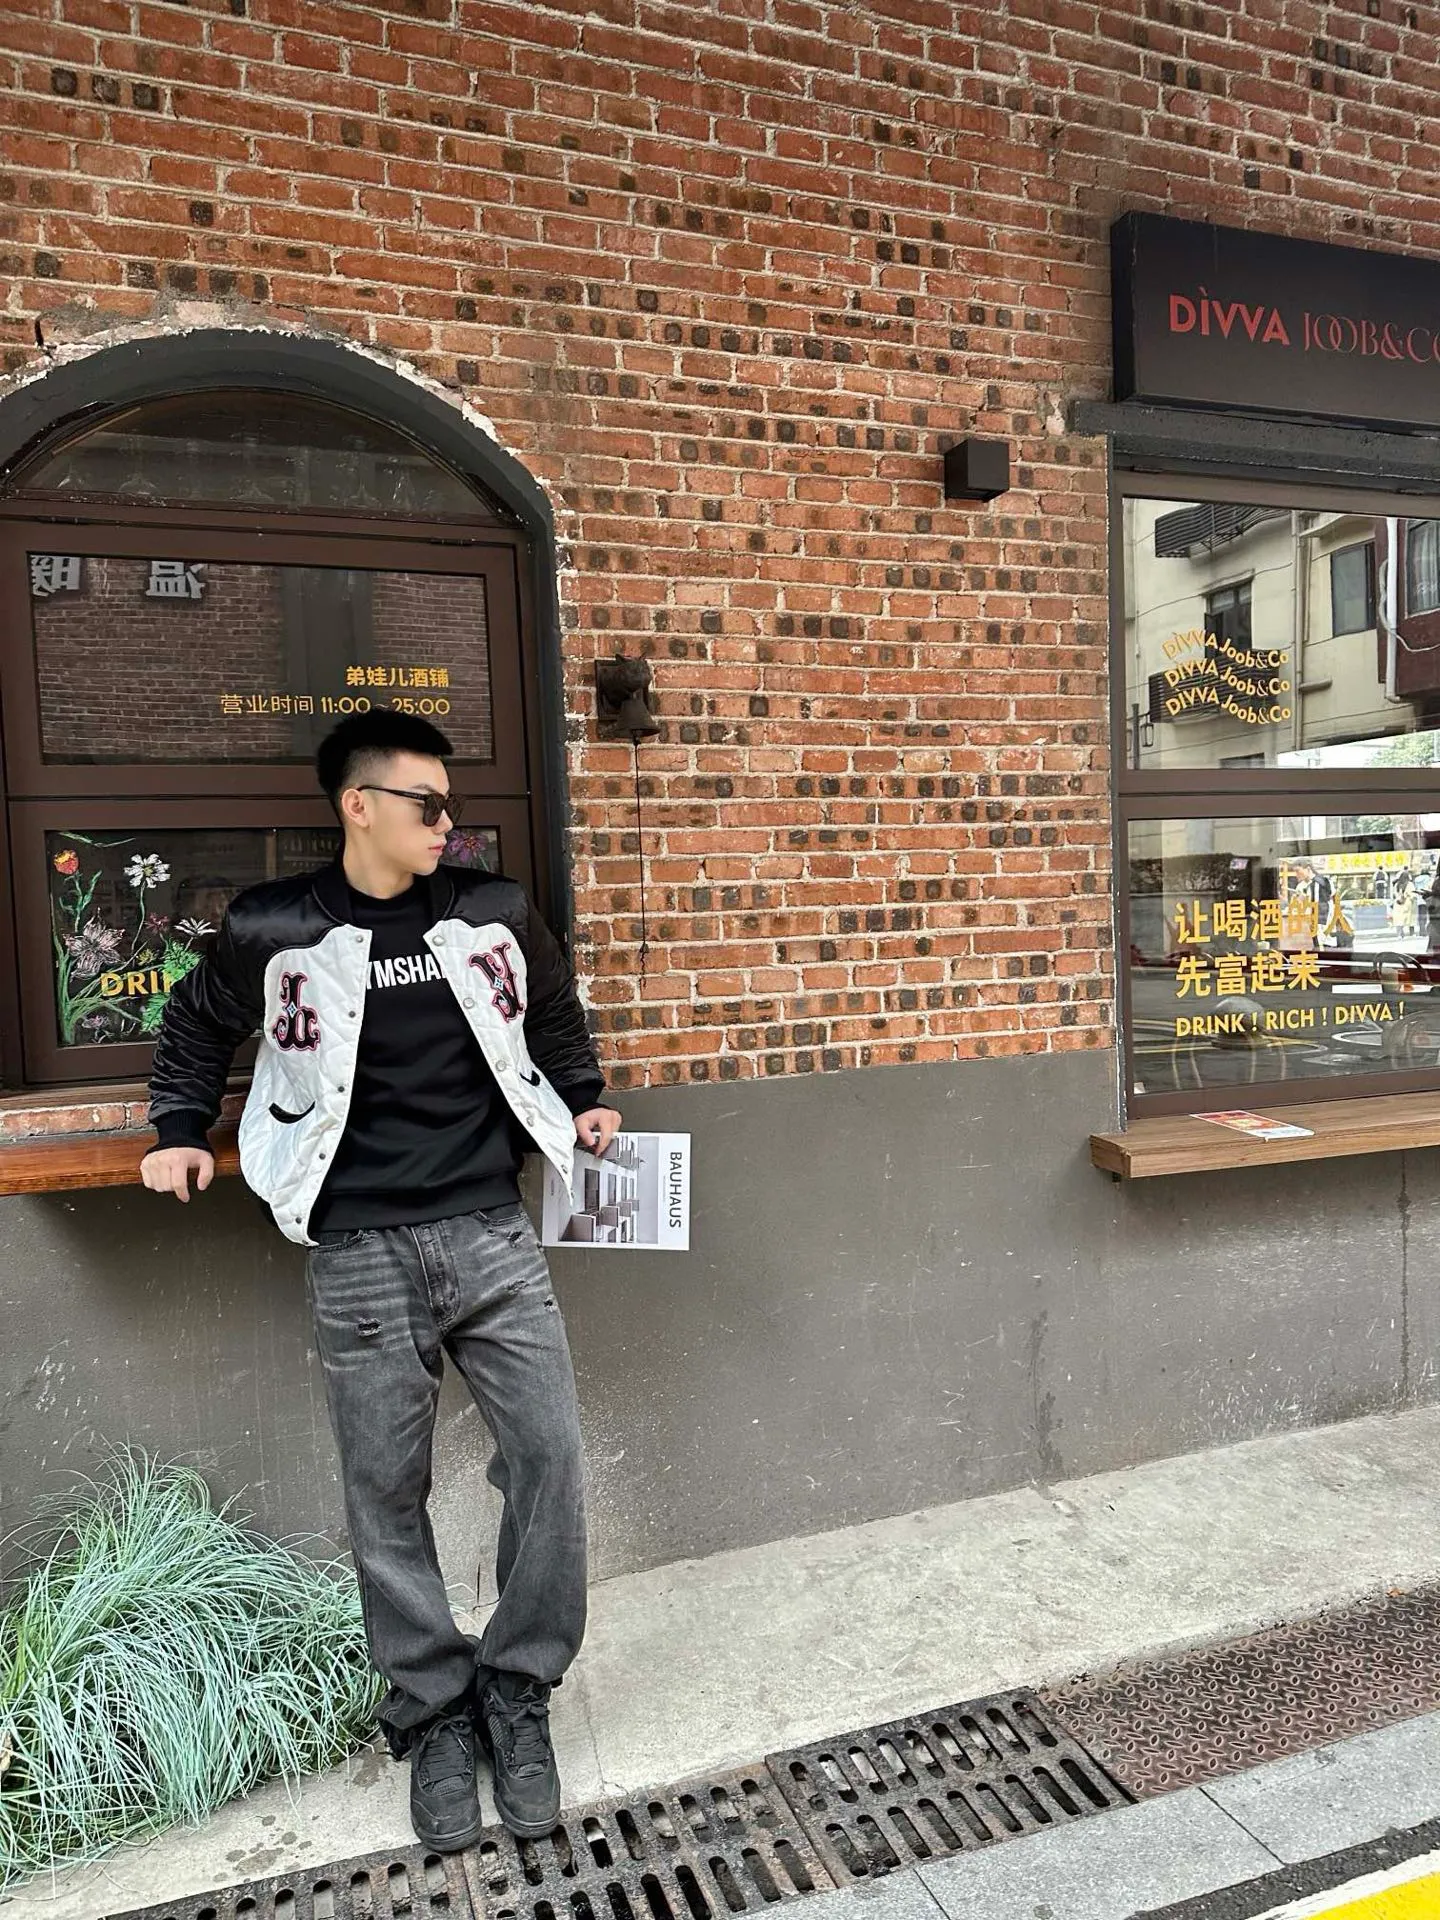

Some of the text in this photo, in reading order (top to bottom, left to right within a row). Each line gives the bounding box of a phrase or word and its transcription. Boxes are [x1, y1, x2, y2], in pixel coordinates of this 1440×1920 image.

[1303, 312, 1440, 364] JOOB&C
[1219, 638, 1289, 669] Joob&Co
[346, 666, 449, 688] 弟娃儿酒铺
[1220, 666, 1290, 697] Joob&Co
[221, 695, 314, 715] 营业时间
[392, 698, 450, 715] 25:00
[1221, 694, 1291, 724] Joob&Co
[1174, 895, 1355, 945] 让喝酒的人
[1174, 950, 1321, 998] 先富起来
[669, 1151, 683, 1229] BAUHAUS
